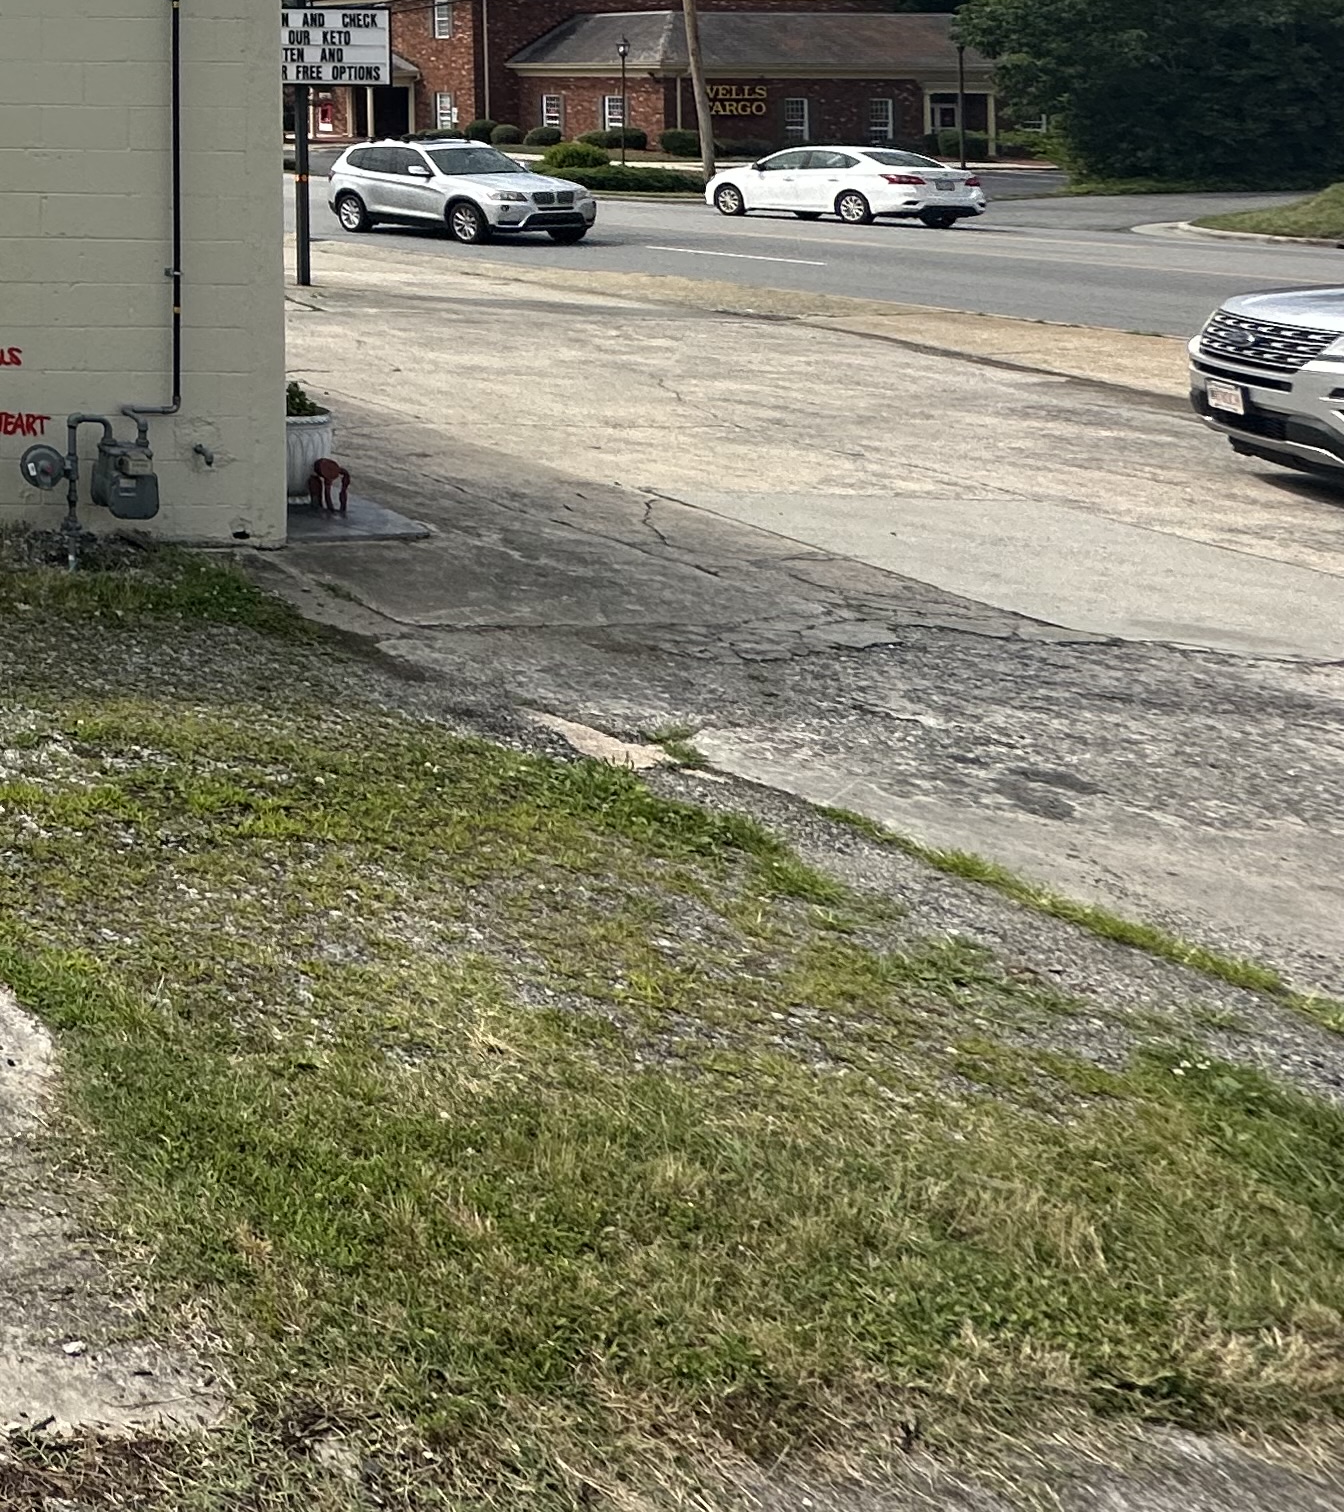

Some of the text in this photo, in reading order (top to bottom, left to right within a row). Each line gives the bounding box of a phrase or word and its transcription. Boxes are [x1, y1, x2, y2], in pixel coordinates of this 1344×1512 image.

[302, 13, 325, 28] AND
[342, 13, 378, 28] CHECK
[288, 30, 351, 45] OUR KETO
[282, 48, 344, 62] TEN AND
[296, 65, 323, 80] FREE
[332, 65, 380, 80] OPTIONS
[707, 101, 767, 116] ARGO
